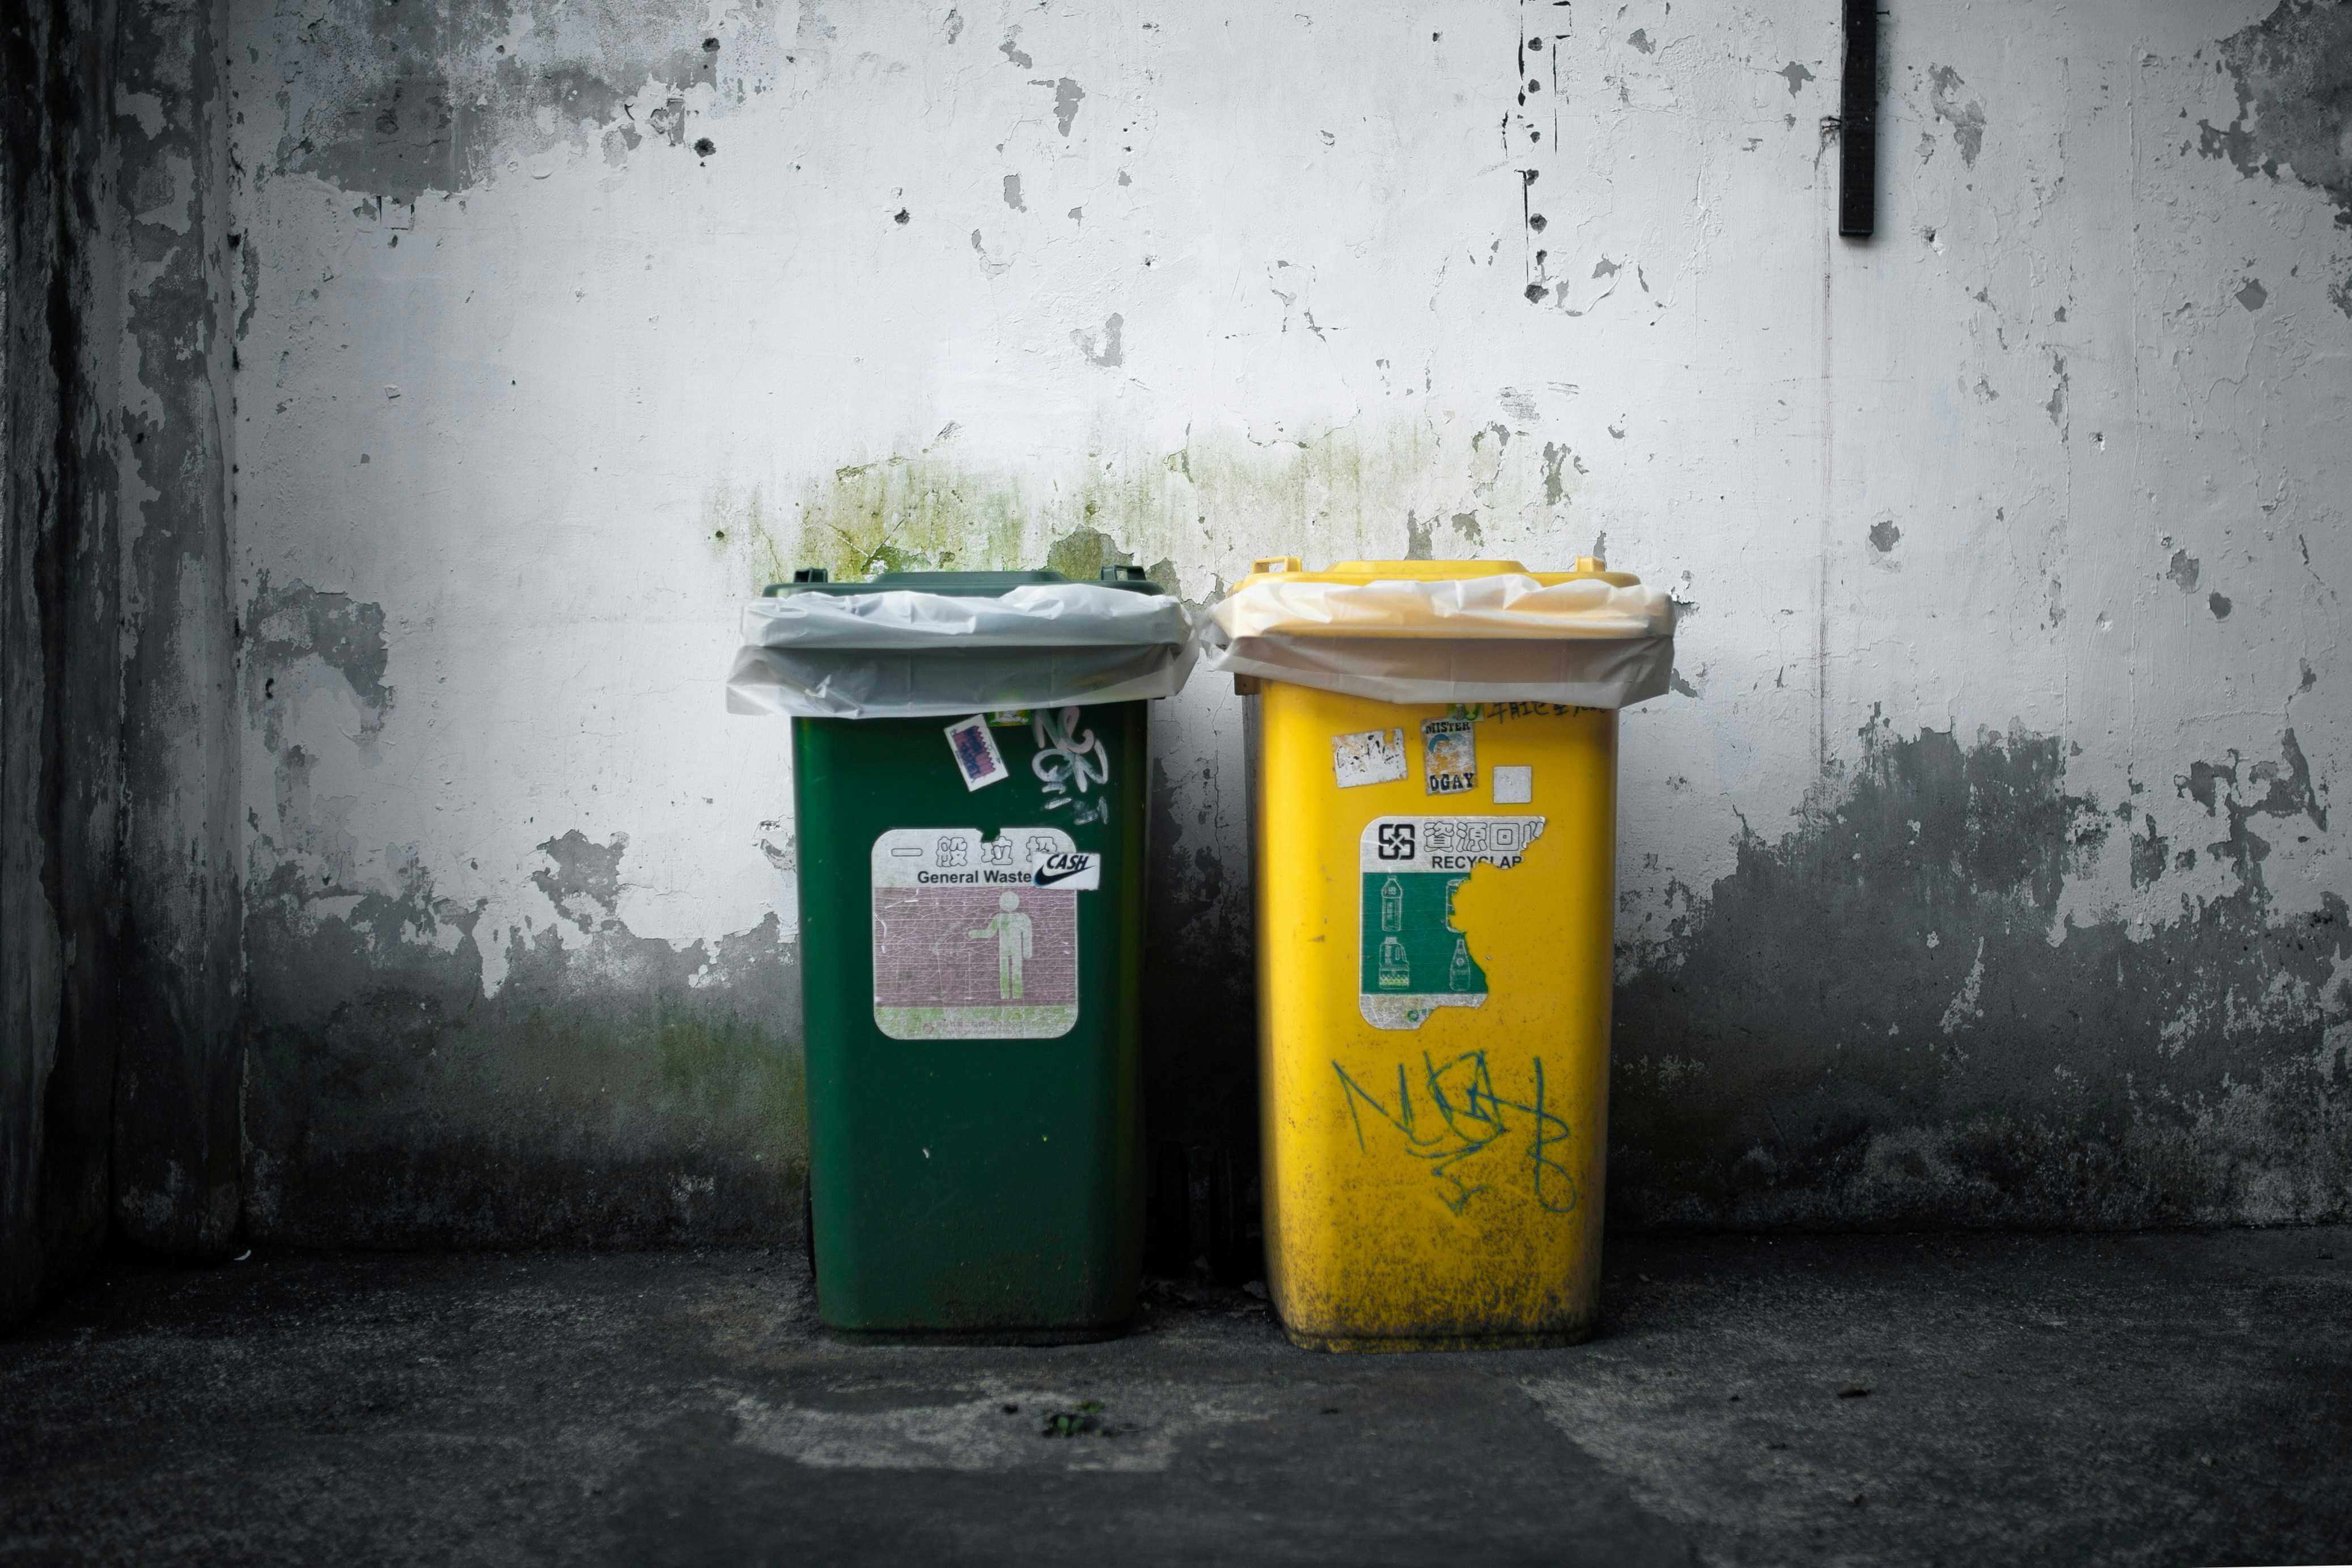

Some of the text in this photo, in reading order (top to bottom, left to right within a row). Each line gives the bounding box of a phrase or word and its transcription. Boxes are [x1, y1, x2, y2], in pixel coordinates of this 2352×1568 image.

[1046, 854, 1089, 870] CASH
[917, 871, 1032, 884] General Waste
